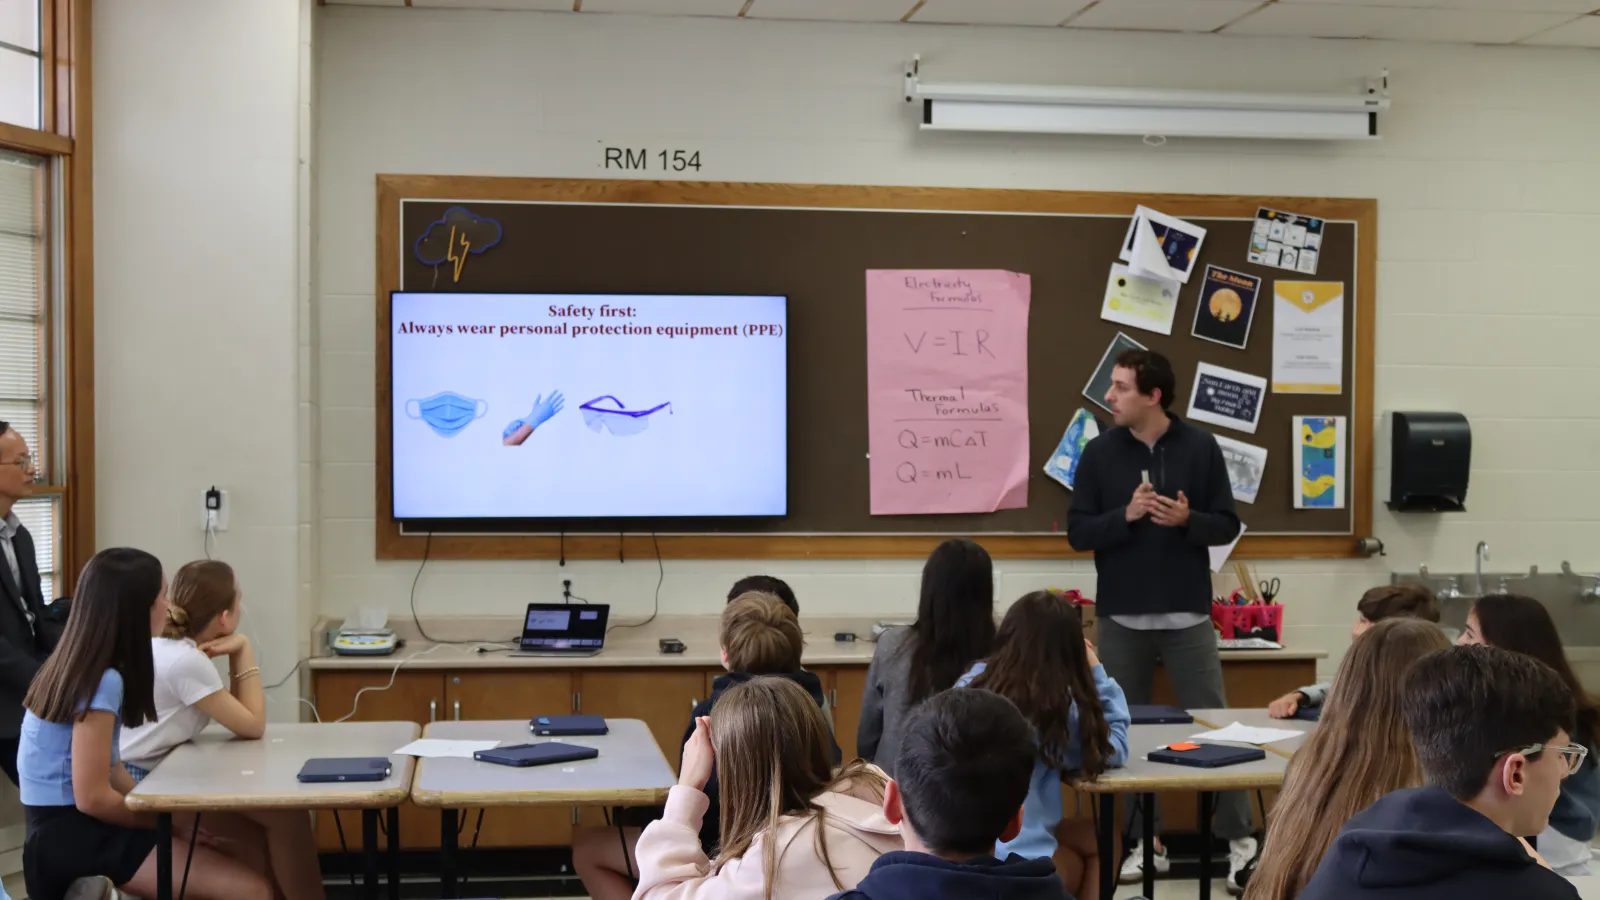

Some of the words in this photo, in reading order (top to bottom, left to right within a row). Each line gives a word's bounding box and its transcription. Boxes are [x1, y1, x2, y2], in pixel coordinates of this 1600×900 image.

[605, 147, 647, 170] RM
[658, 149, 702, 172] 154
[548, 304, 595, 320] Safety
[599, 304, 637, 317] first:
[397, 321, 453, 338] Always
[457, 324, 496, 335] wear
[499, 322, 567, 338] personal
[571, 322, 652, 338] protection
[656, 322, 738, 339] equipment
[742, 323, 784, 338] (PPE)
[905, 385, 965, 402] Thermal
[935, 402, 1000, 415] Formulas
